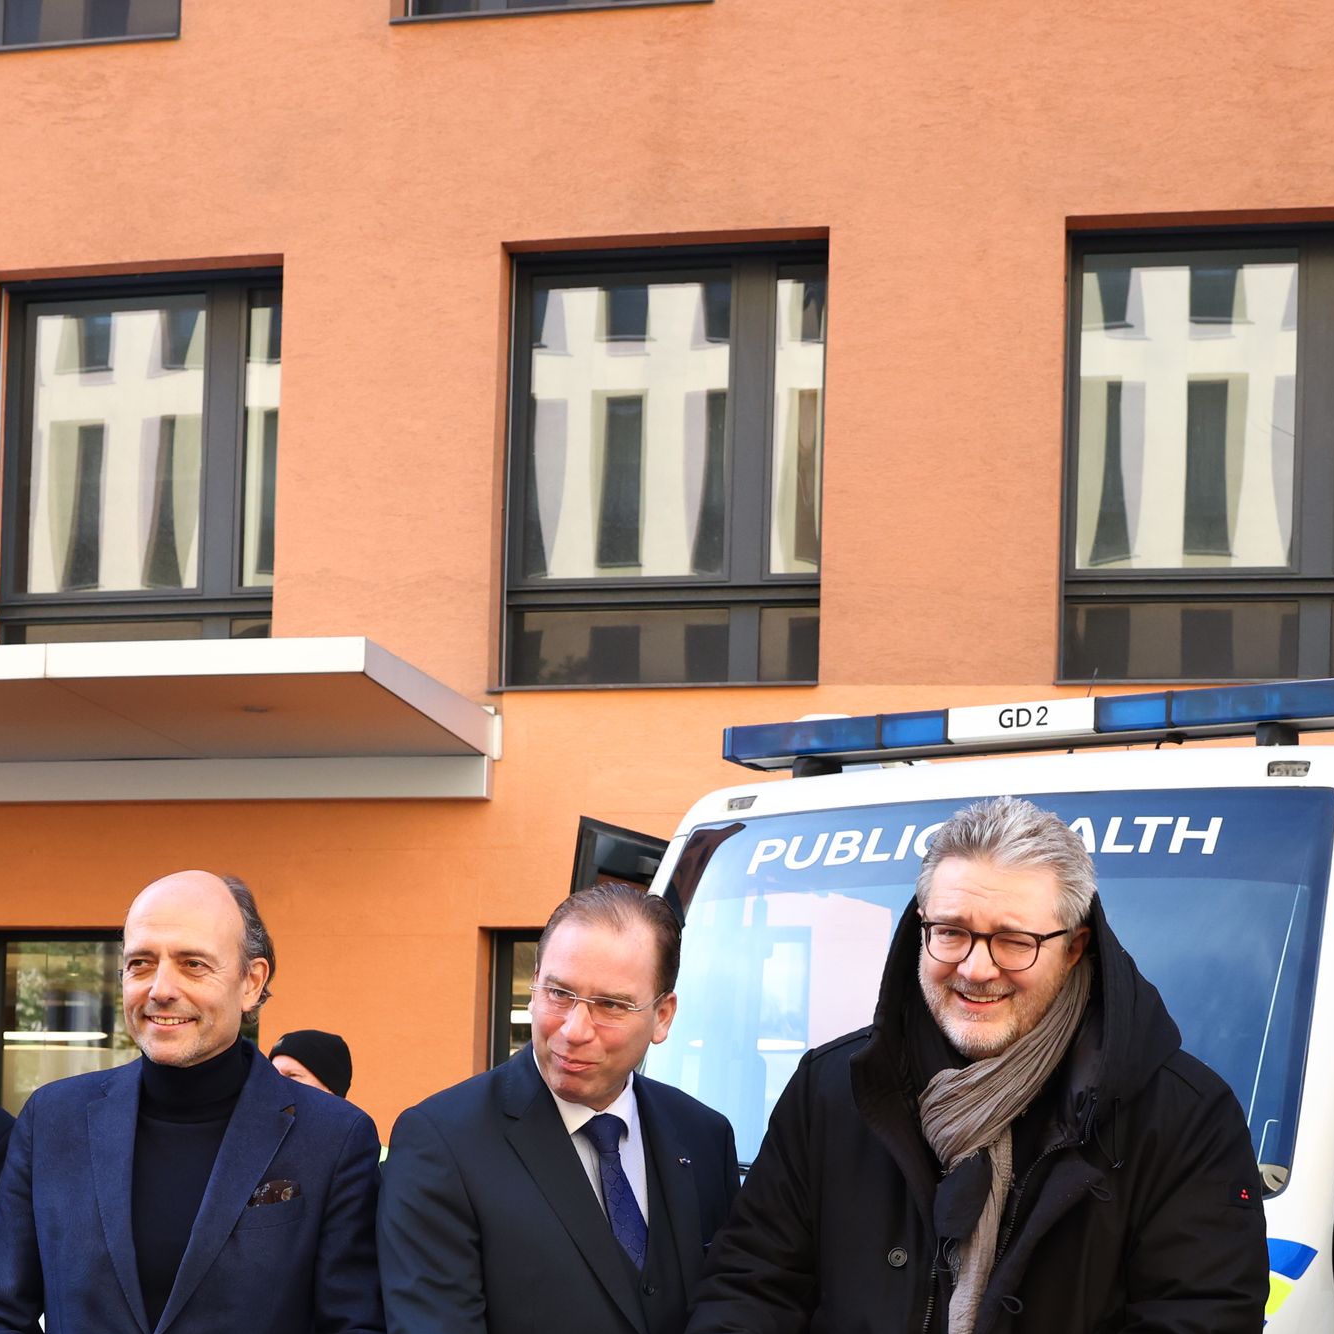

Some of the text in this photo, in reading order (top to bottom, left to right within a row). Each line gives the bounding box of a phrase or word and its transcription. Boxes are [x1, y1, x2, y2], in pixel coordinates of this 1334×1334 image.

[998, 705, 1048, 728] GD 2
[1068, 816, 1224, 854] ALTH
